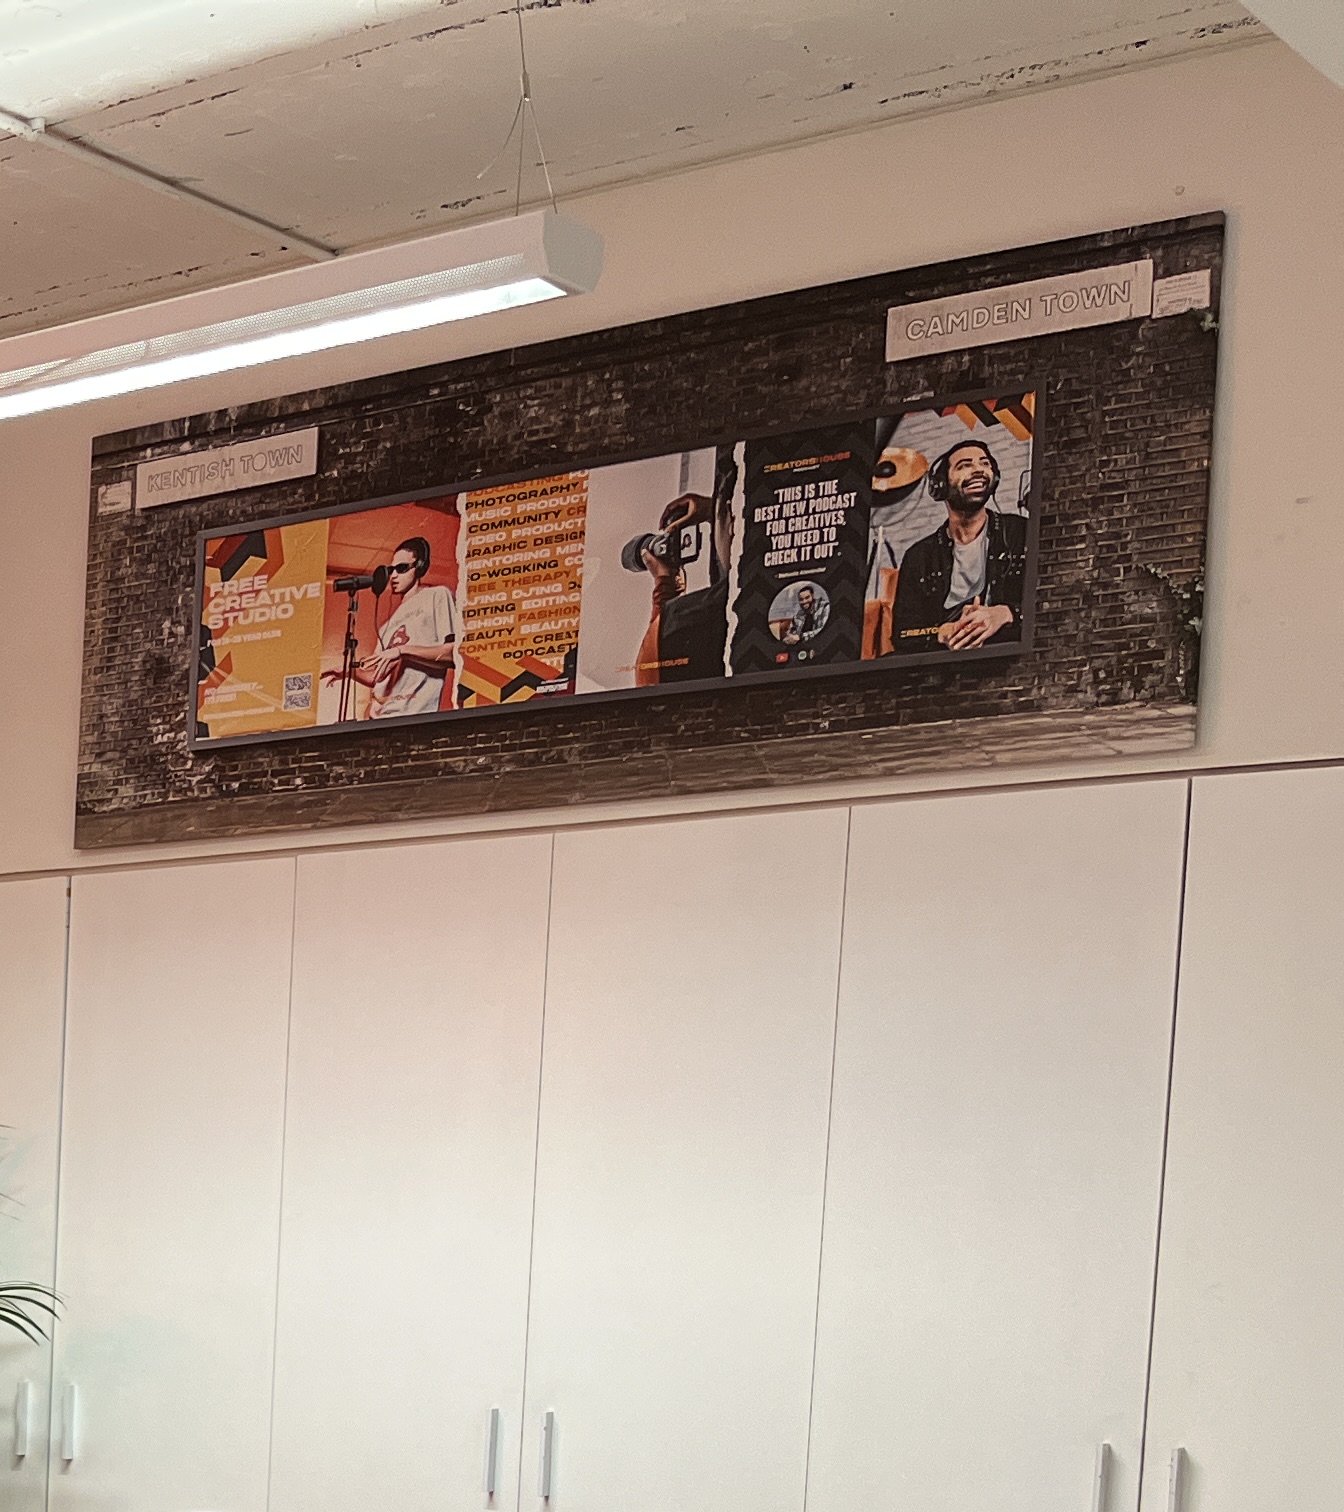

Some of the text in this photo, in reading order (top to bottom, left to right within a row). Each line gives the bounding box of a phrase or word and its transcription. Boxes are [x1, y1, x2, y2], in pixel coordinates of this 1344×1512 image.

[906, 298, 1032, 340] CAMDEN
[1041, 280, 1130, 317] TOWN
[147, 445, 303, 492] KENTISH TOWN
[465, 482, 579, 510] PHOTOGRAPHY
[804, 484, 816, 501] IS
[818, 479, 839, 497] THE
[754, 492, 857, 523] BEST NEW PODCAST
[468, 509, 562, 534] COMMUNITY
[766, 510, 847, 536] FOR CREATIVES,
[771, 527, 837, 550] YOU NEED TO
[764, 548, 798, 567] CHECK
[800, 546, 812, 562] IT
[467, 559, 559, 582] O-WORKING
[503, 570, 571, 588] THERAPY
[209, 574, 269, 597] FREE
[208, 582, 321, 613] CREATIVE
[208, 603, 294, 630] STUDIO
[518, 605, 581, 622] FASHION
[520, 618, 580, 635] BEAUTY
[532, 630, 580, 644] CREAT
[503, 642, 578, 659] PODCAST
